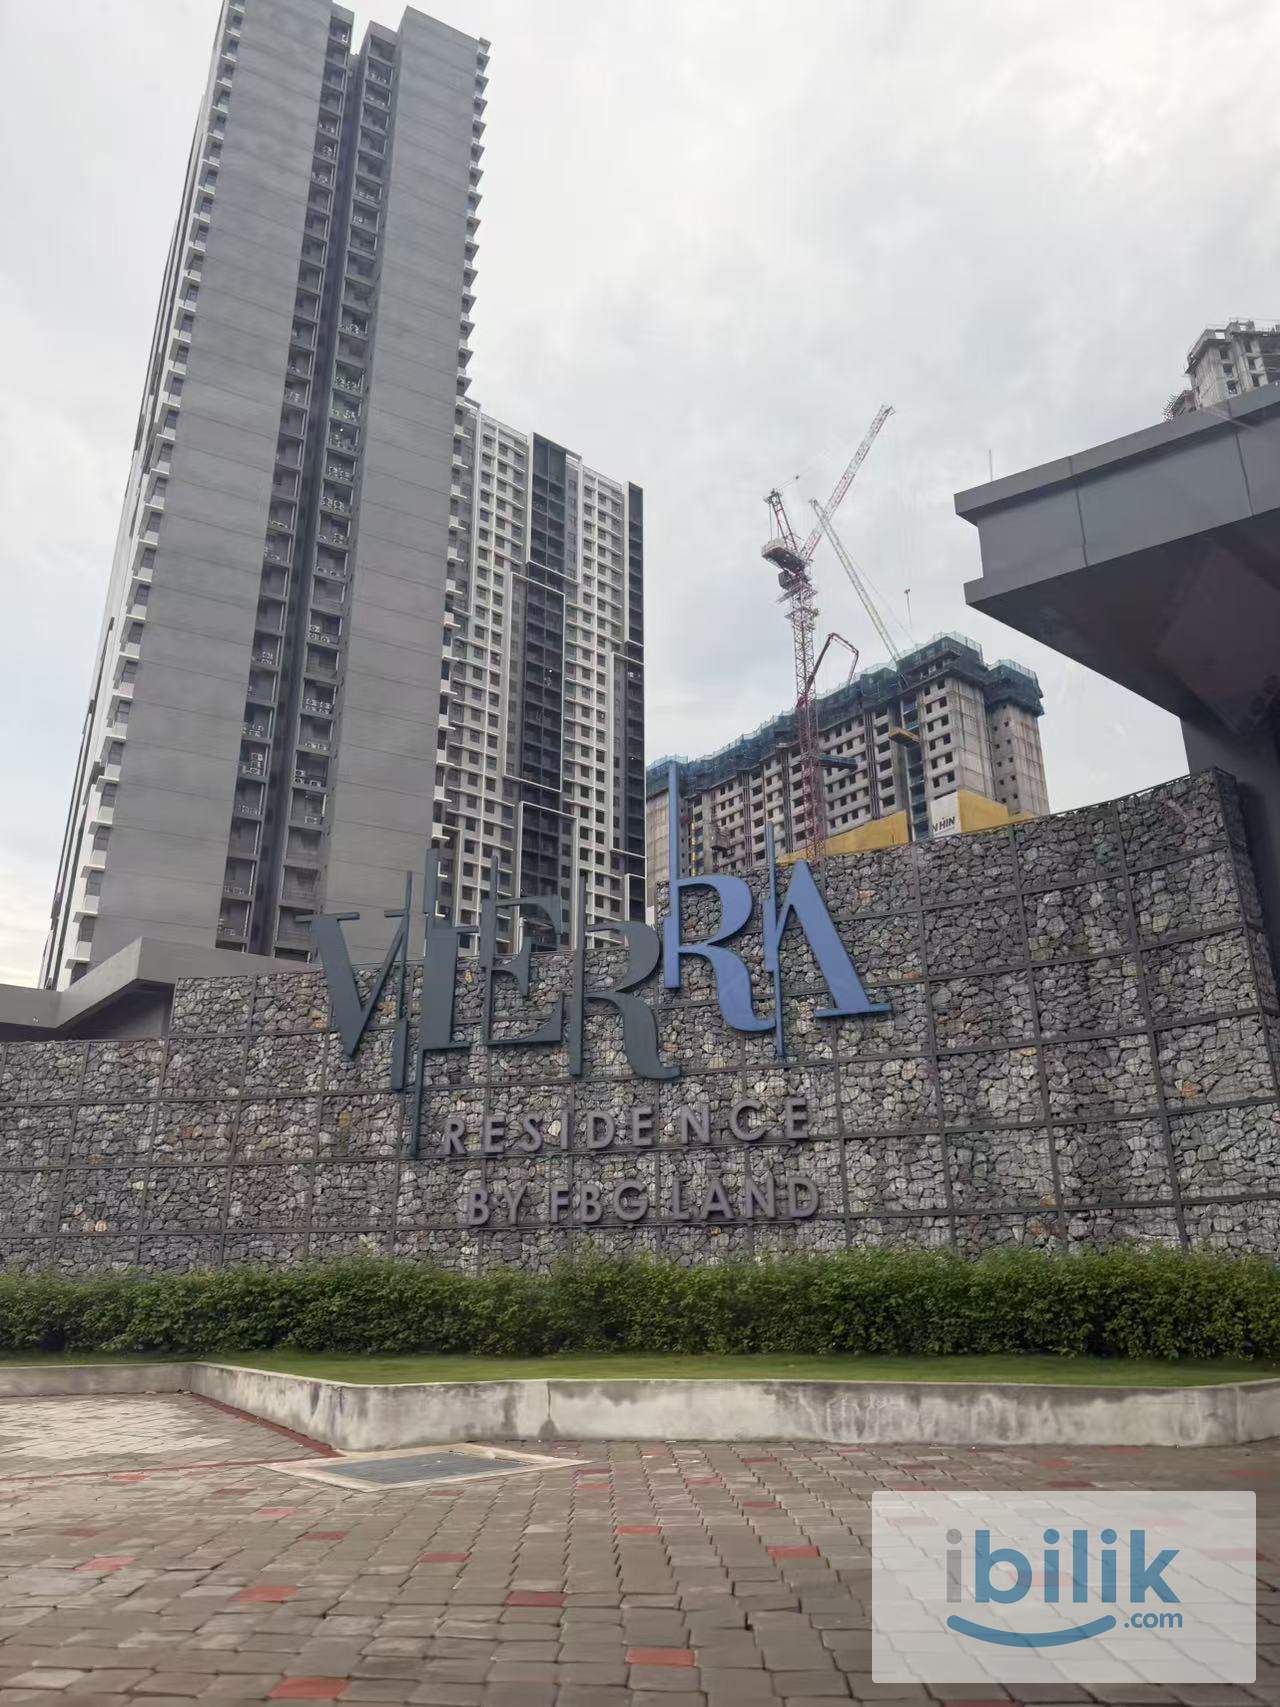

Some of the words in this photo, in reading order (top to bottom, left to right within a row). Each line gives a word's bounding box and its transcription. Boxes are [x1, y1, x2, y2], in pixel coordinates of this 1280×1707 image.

[443, 1099, 809, 1156] RESIDENCE
[466, 1184, 527, 1226] BY
[551, 1178, 650, 1223] FBG
[671, 1174, 820, 1221] LAND
